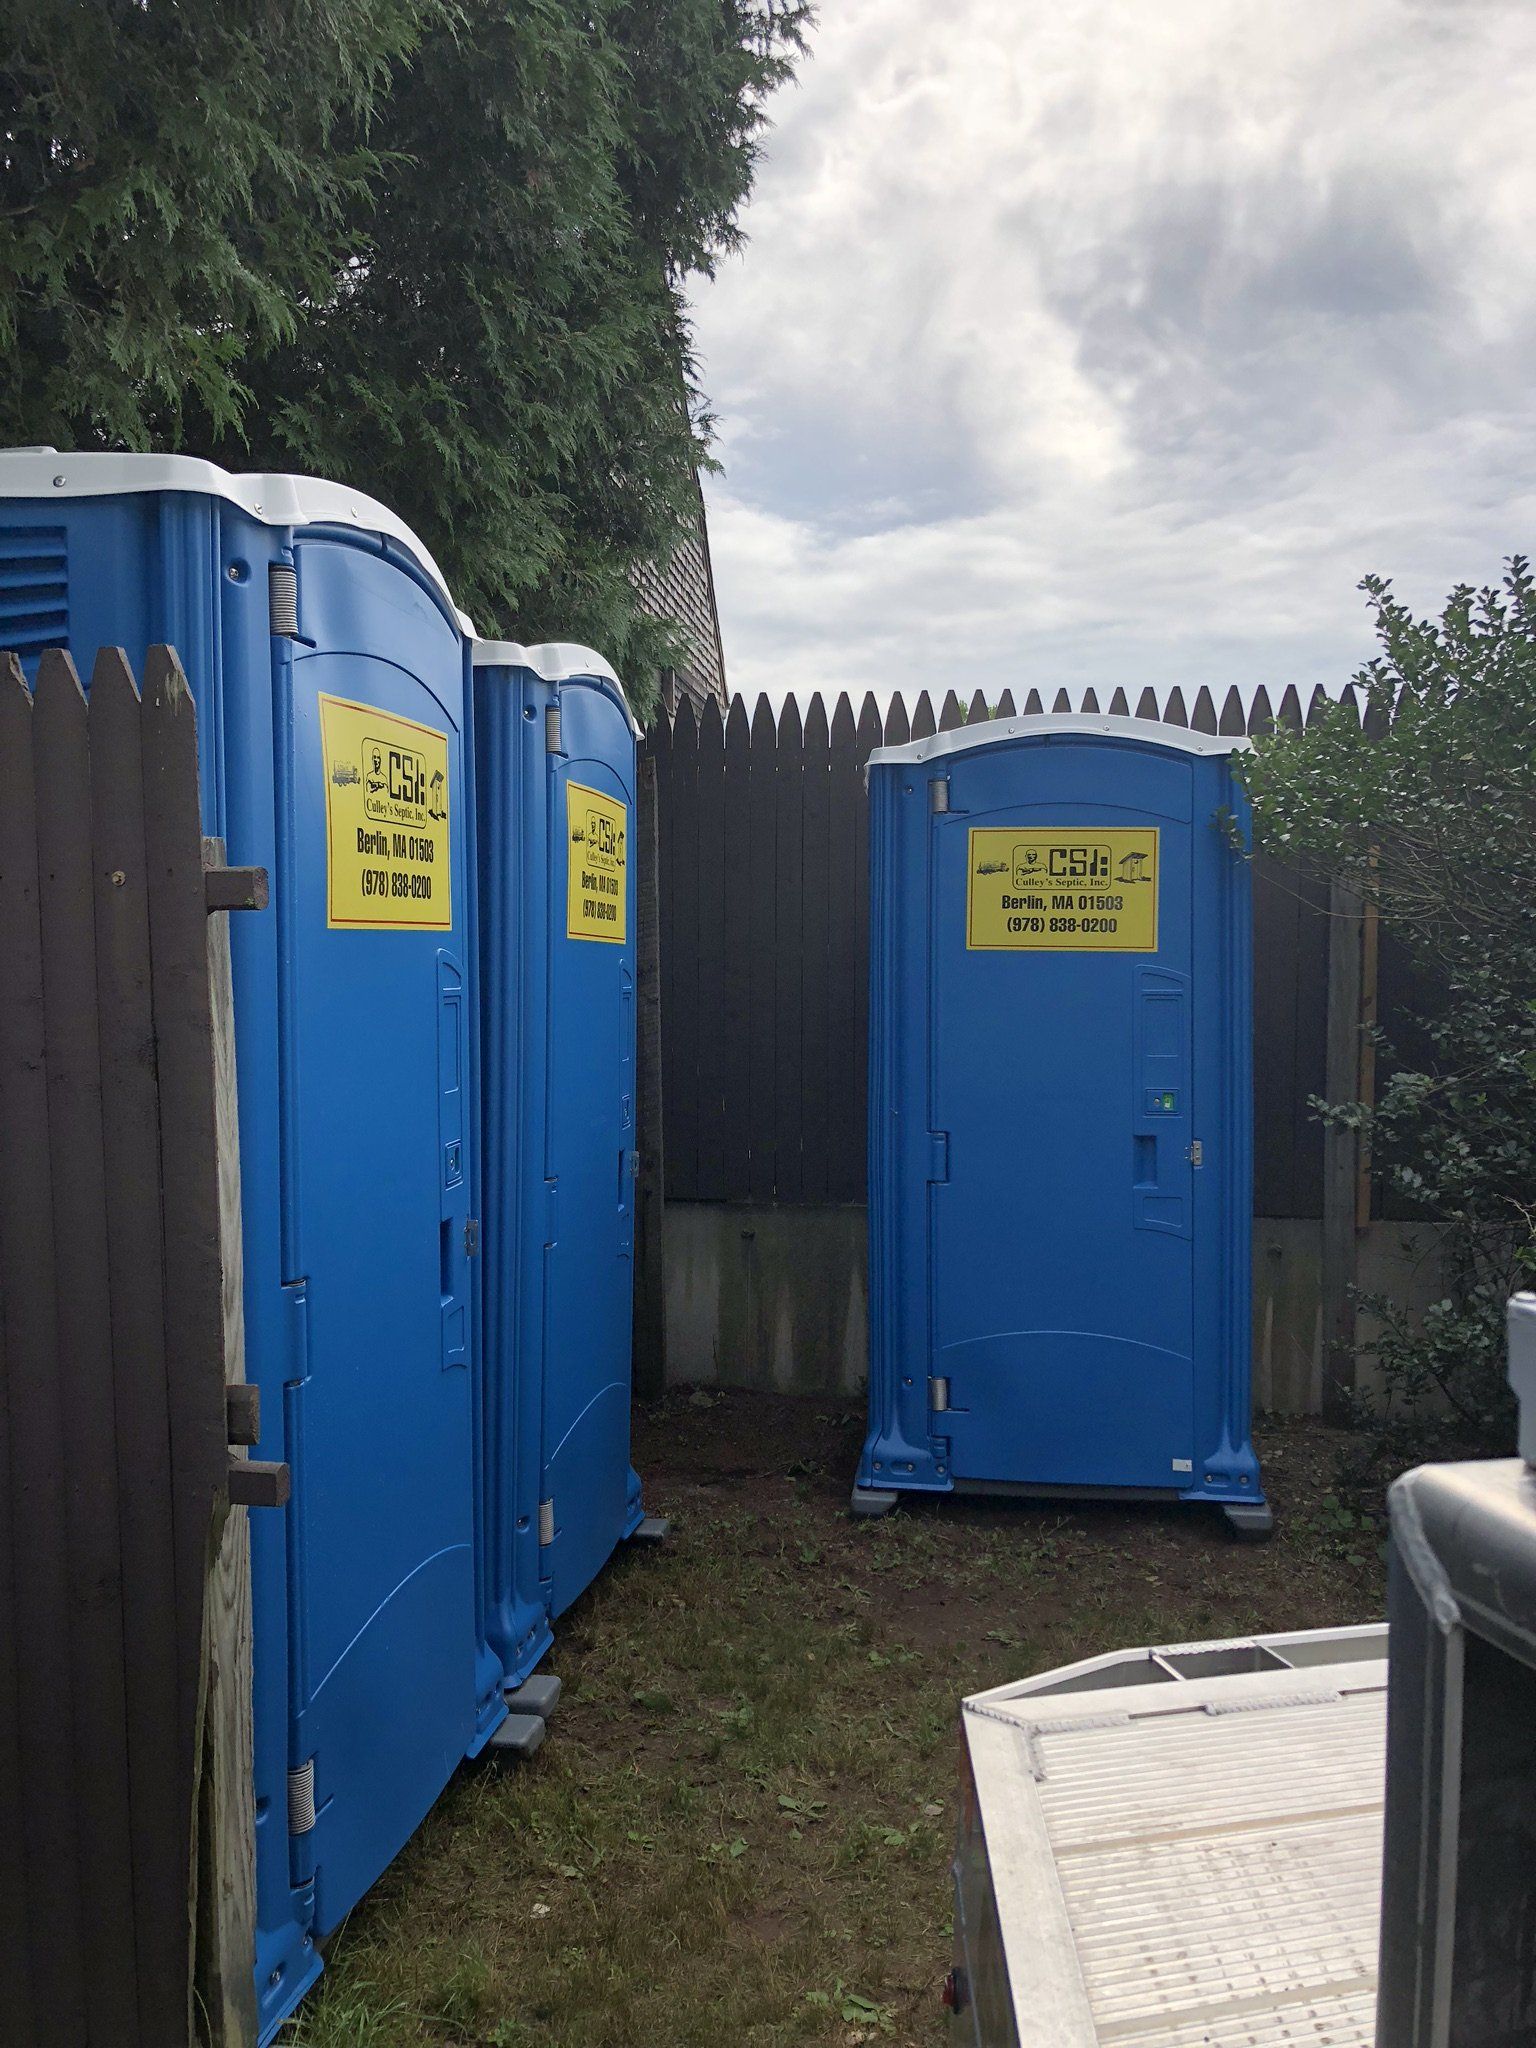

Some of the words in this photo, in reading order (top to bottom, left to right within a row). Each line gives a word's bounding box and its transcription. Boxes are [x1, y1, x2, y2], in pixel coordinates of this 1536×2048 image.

[366, 798, 393, 817] Culley's
[415, 808, 426, 821] Inc.
[357, 828, 391, 860] Berlin,
[393, 833, 407, 859] MA
[409, 837, 434, 863] 01503
[361, 869, 389, 897] (978)
[391, 873, 432, 900] 838-0200
[582, 870, 598, 893] Berlin,
[599, 874, 606, 892] MA
[1015, 877, 1053, 888] Culley's
[1090, 878, 1108, 887] Inc.
[583, 898, 596, 919] (978)
[1001, 895, 1047, 911] Berlin,
[1052, 895, 1074, 910] MA
[1078, 895, 1123, 910] 01503
[1007, 917, 1045, 933] (978)
[1049, 917, 1118, 933] 838-0200
